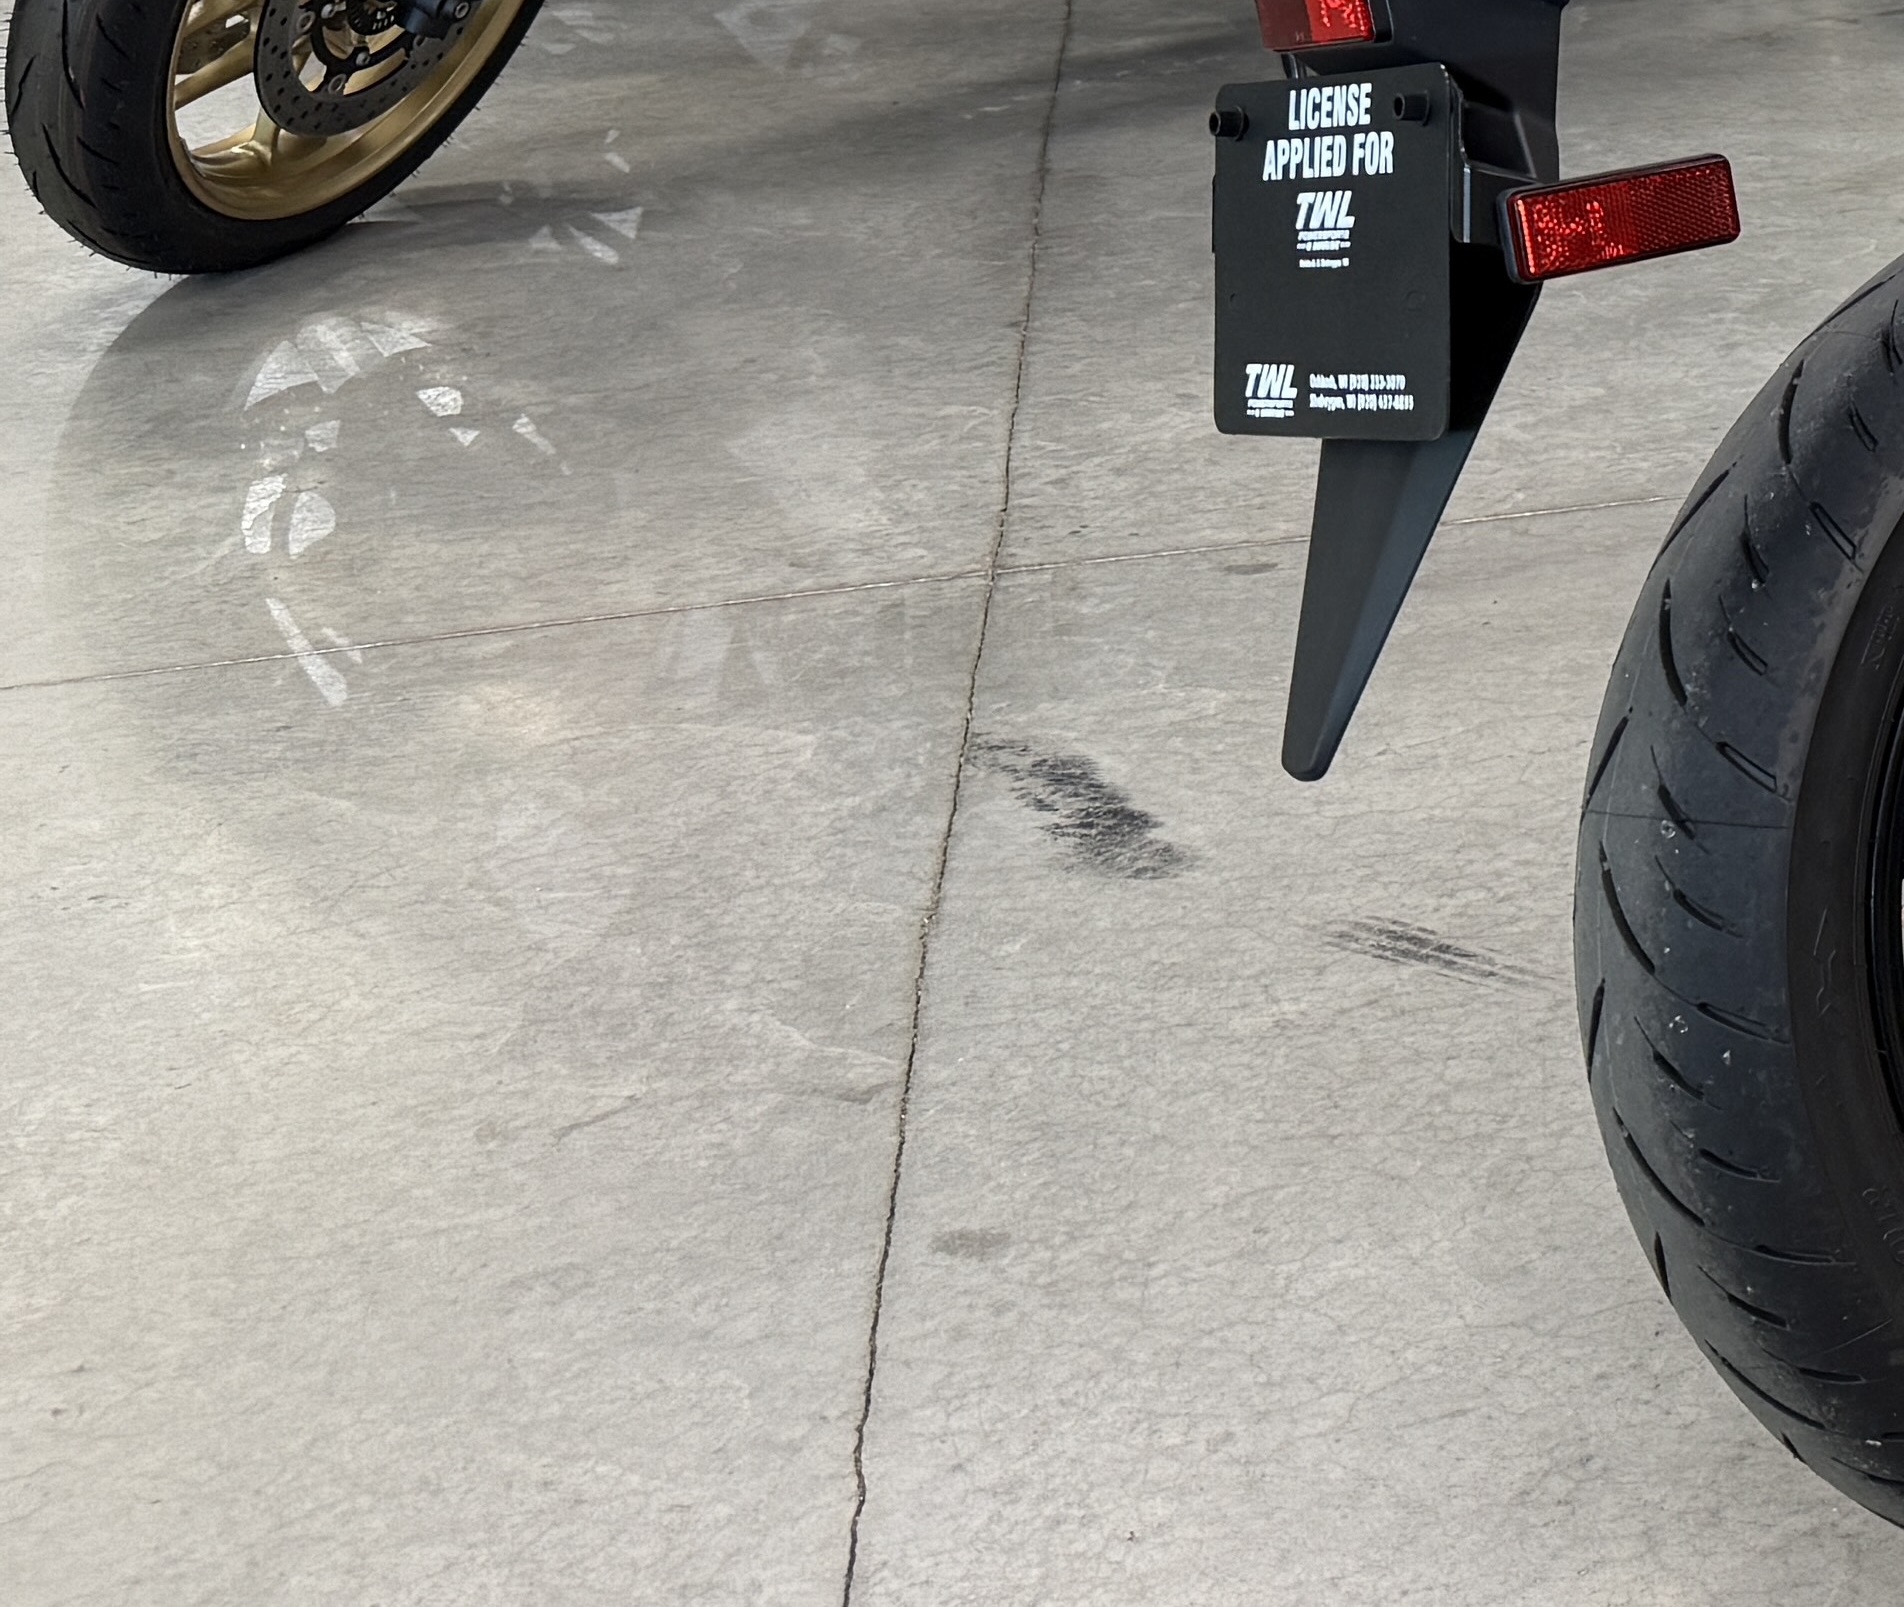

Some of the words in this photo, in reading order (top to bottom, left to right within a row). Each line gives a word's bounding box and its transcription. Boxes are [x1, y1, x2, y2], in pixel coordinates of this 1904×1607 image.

[1288, 82, 1372, 130] LICENSE
[1262, 135, 1347, 181] APPLIED
[1352, 131, 1394, 176] FOR
[1295, 190, 1355, 230] TWL
[1245, 363, 1298, 399] TWL
